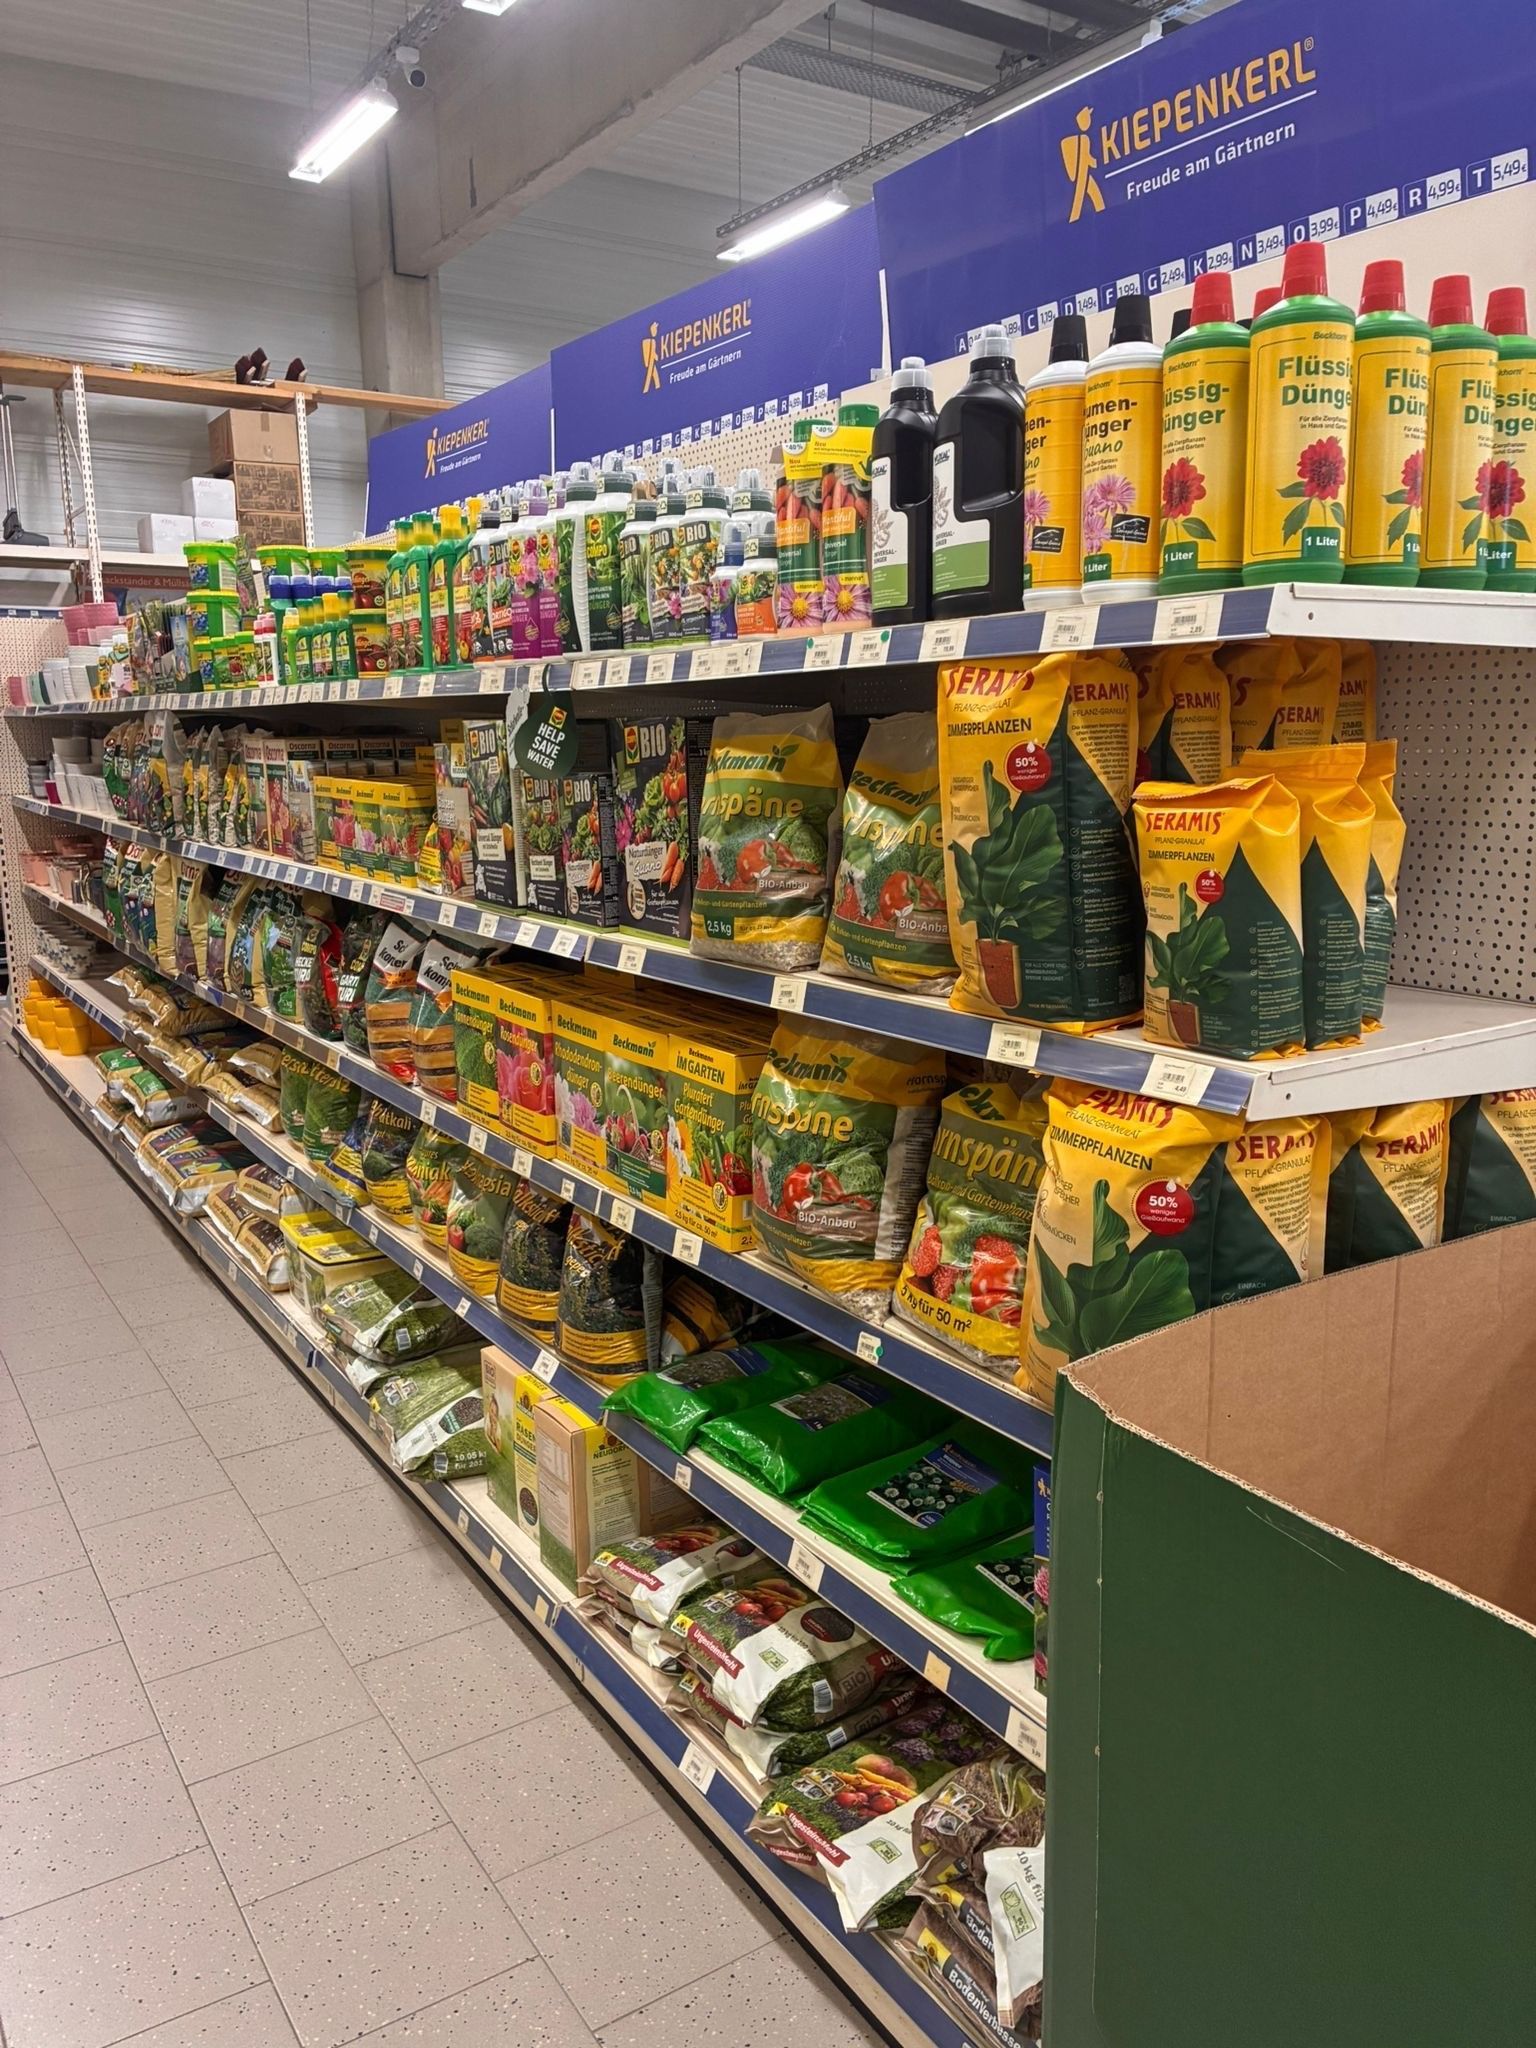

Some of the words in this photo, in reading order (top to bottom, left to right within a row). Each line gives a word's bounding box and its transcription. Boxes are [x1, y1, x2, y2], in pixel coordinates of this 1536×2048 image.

[1126, 165, 1181, 200] Freude
[1185, 156, 1210, 177] am
[1214, 121, 1296, 167] Gärtnern
[1472, 168, 1486, 188] T
[1408, 187, 1422, 208] R
[1350, 207, 1361, 225] P
[1241, 241, 1253, 260] N
[1194, 259, 1203, 276] K
[1148, 274, 1157, 290] G
[1105, 289, 1114, 304] F
[660, 299, 751, 360] KIEPENKERL
[1027, 314, 1036, 330] C
[958, 338, 967, 352] A
[669, 366, 694, 384] Freude
[695, 362, 707, 374] am
[708, 349, 741, 370] Gärtnern
[1385, 368, 1429, 391] Flüs
[1163, 380, 1230, 408] üssig-
[1282, 384, 1352, 410] Dünge
[1083, 418, 1132, 439] ünger
[1163, 408, 1226, 434] ünger
[686, 523, 707, 543] BIO
[1305, 536, 1312, 547] 1
[1316, 535, 1339, 548] Liter
[1088, 562, 1108, 572] Liter
[1170, 550, 1193, 562] Liter
[479, 728, 497, 755] BIO
[538, 723, 566, 743] HELP
[639, 723, 667, 758] BIO
[532, 736, 561, 758] SAVE
[527, 749, 555, 771] WATER
[1015, 756, 1039, 768] 50%
[534, 780, 550, 798] BIO
[573, 779, 591, 803] BIO
[1145, 811, 1222, 835] SERAMIS
[758, 878, 810, 890] BIO-Anbau
[707, 919, 719, 935] 2,5
[720, 920, 732, 937] kg
[455, 982, 490, 1005] Beckmann
[499, 998, 537, 1023] Beckmann
[557, 1014, 597, 1040] Beckmann
[613, 1033, 654, 1058] Beckmann
[607, 1068, 663, 1099] Beerendünger
[674, 1098, 726, 1133] Gartendünger
[1050, 1124, 1153, 1172] ZIMMERPFLANZEN
[1148, 1195, 1179, 1209] 50%
[1149, 1208, 1177, 1217] weniger
[798, 1210, 857, 1230] BIO-Anbau
[918, 1298, 934, 1317] für
[936, 1307, 951, 1325] 50
[953, 1319, 973, 1333] m²
[693, 1628, 738, 1671] UrgesteinsMehl
[841, 1671, 867, 1693] BIO
[788, 1812, 841, 1859] UrgesteinsMehl
[1016, 1850, 1030, 1867] 10
[1023, 1868, 1037, 1890] kg
[965, 1913, 995, 1953] Boden
